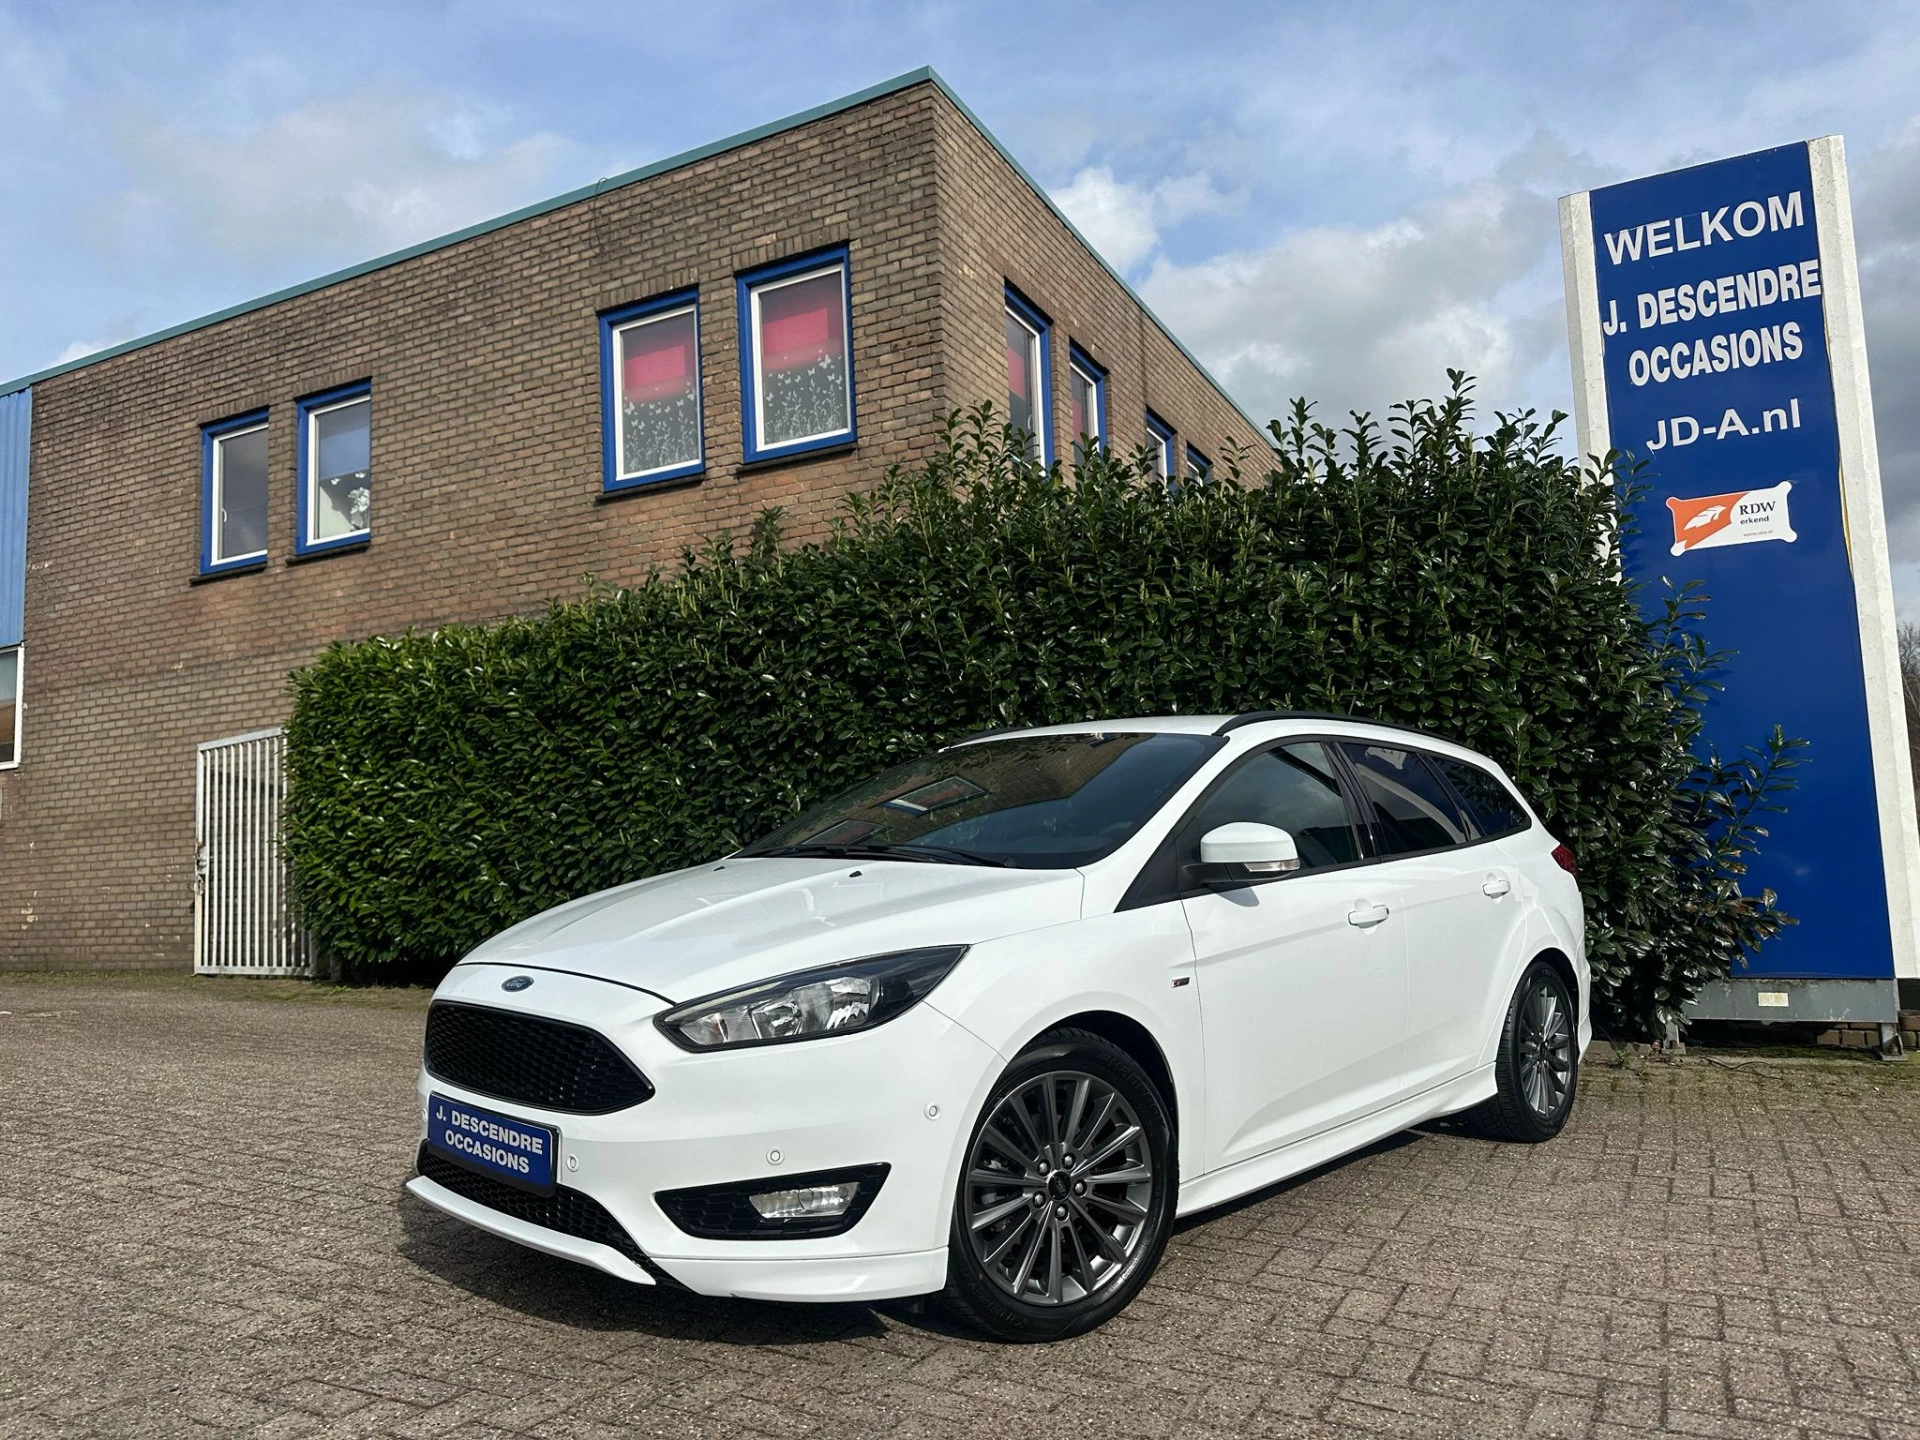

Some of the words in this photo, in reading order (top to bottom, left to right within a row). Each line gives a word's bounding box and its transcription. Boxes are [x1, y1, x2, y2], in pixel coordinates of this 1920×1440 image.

[1603, 190, 1804, 266] WELKOM
[1603, 299, 1627, 336] J.
[1637, 258, 1822, 330] DESCENDRE
[1628, 321, 1803, 388] OCCASIONS
[1645, 398, 1801, 452] JD-A.nl
[1739, 500, 1776, 516] RDW
[1740, 514, 1770, 525] erkend
[435, 1105, 447, 1122] J.
[451, 1110, 543, 1155] DESCENDRE
[445, 1129, 530, 1174] OCCASIONS
